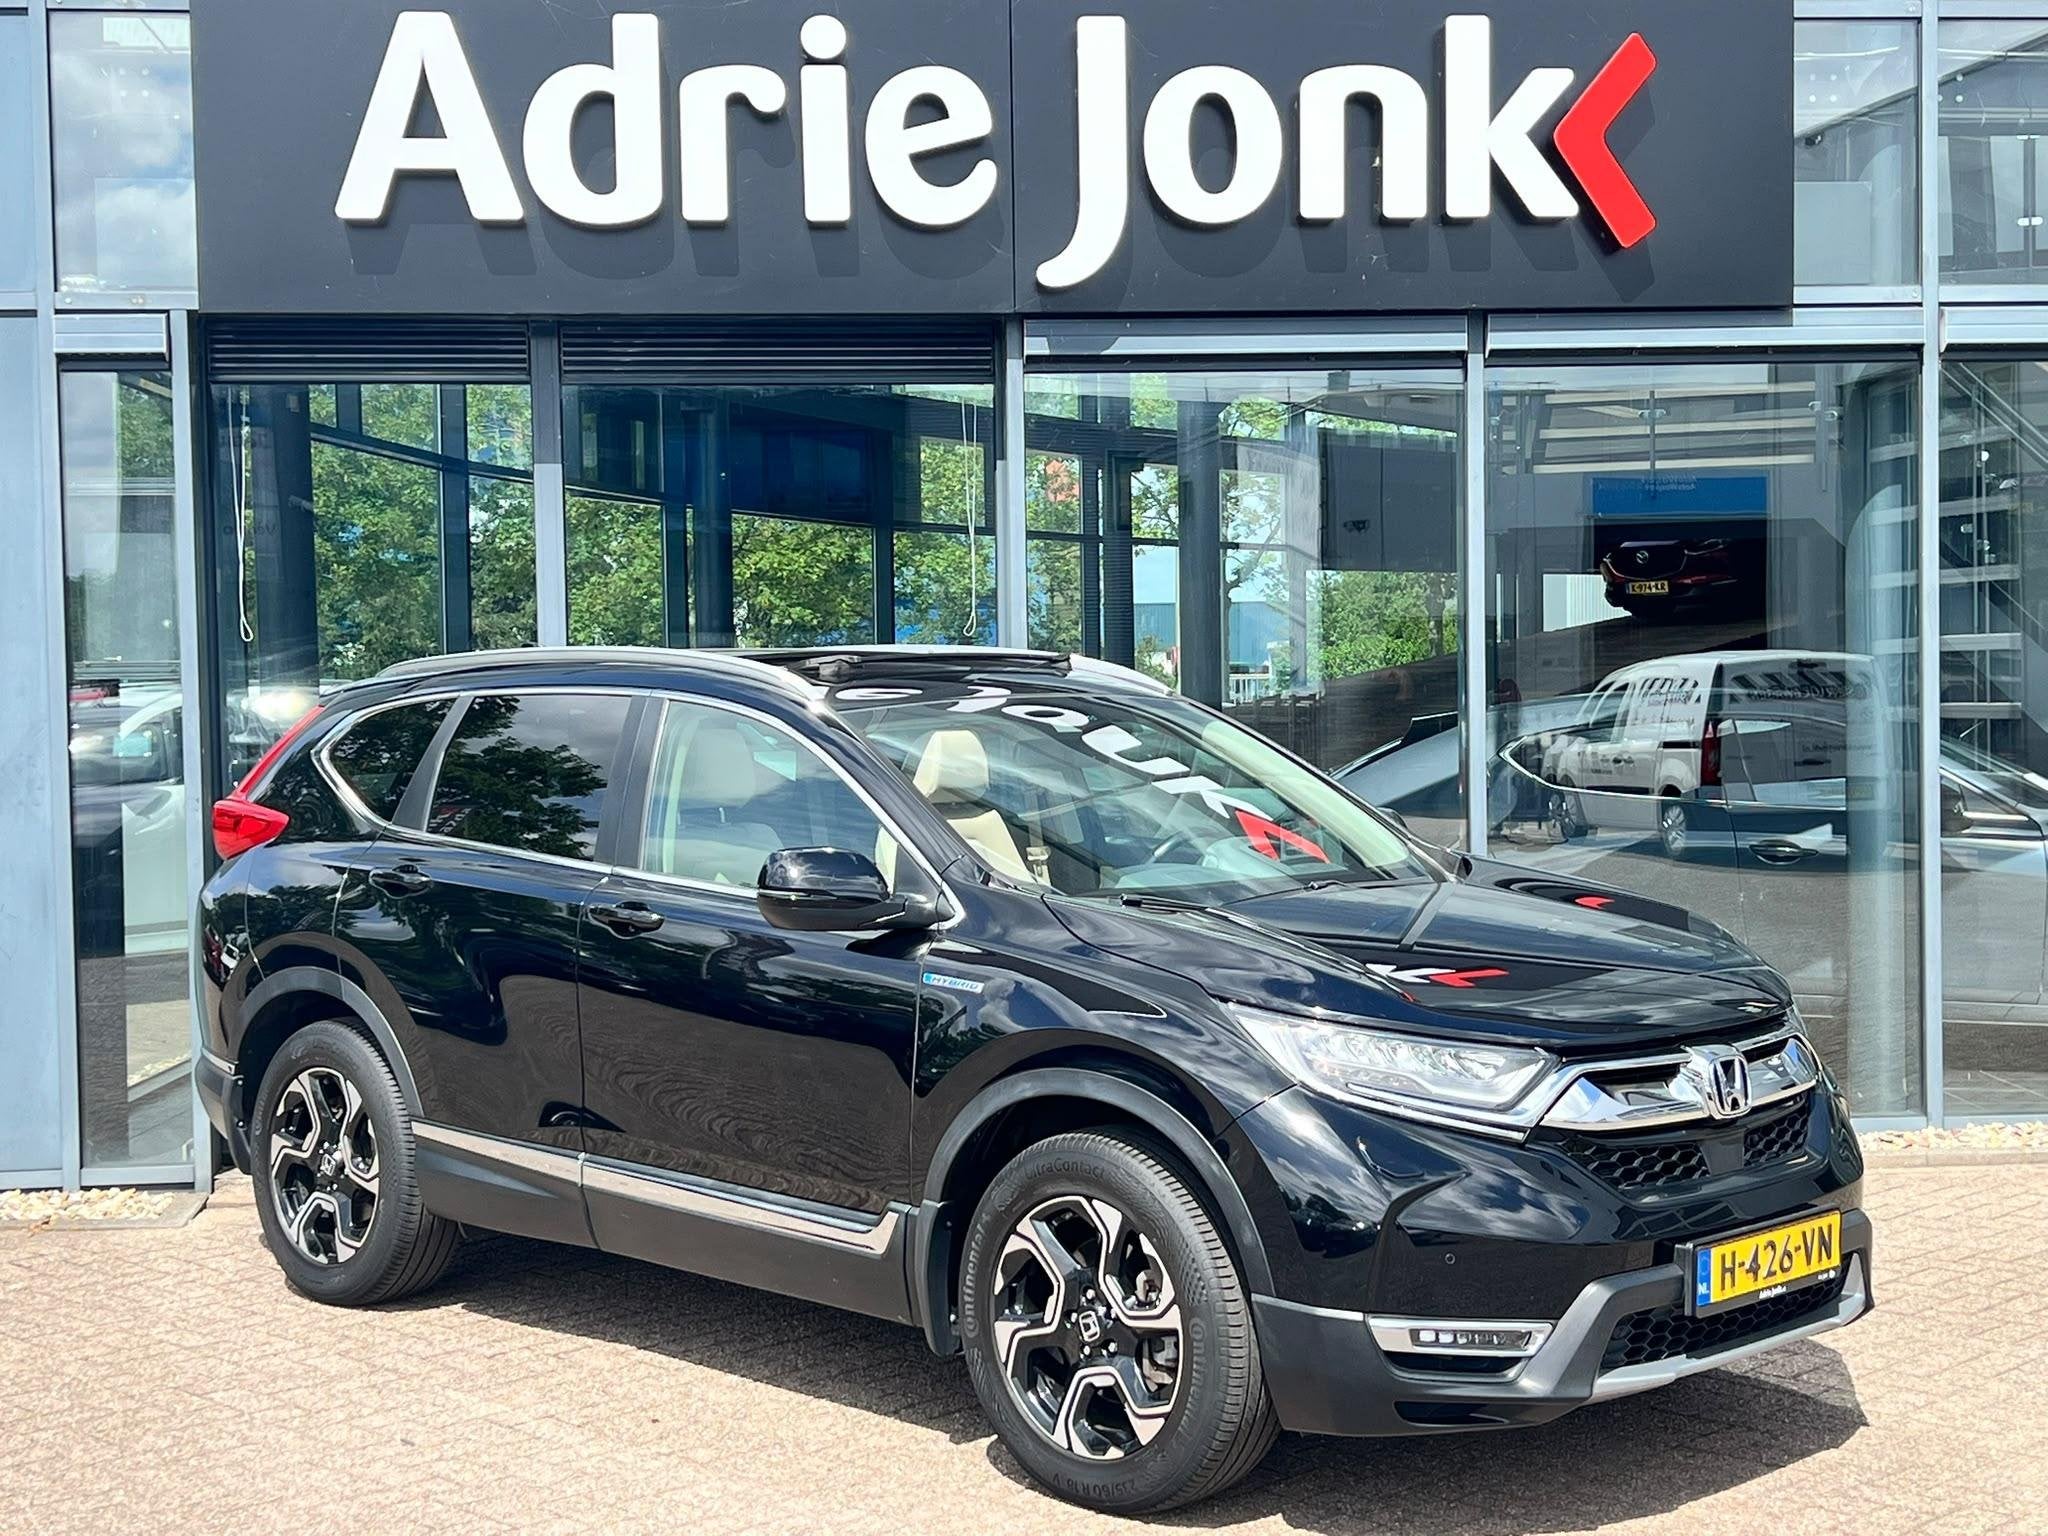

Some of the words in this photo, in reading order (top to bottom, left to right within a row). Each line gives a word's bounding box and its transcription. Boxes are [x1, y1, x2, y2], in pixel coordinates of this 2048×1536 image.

[335, 11, 998, 226] Adrie
[1036, 15, 1579, 288] Jonk
[932, 976, 980, 990] HYBRID
[962, 1223, 987, 1339] Continental
[1697, 1281, 1710, 1296] NL
[1720, 1222, 1833, 1292] H-426-VN
